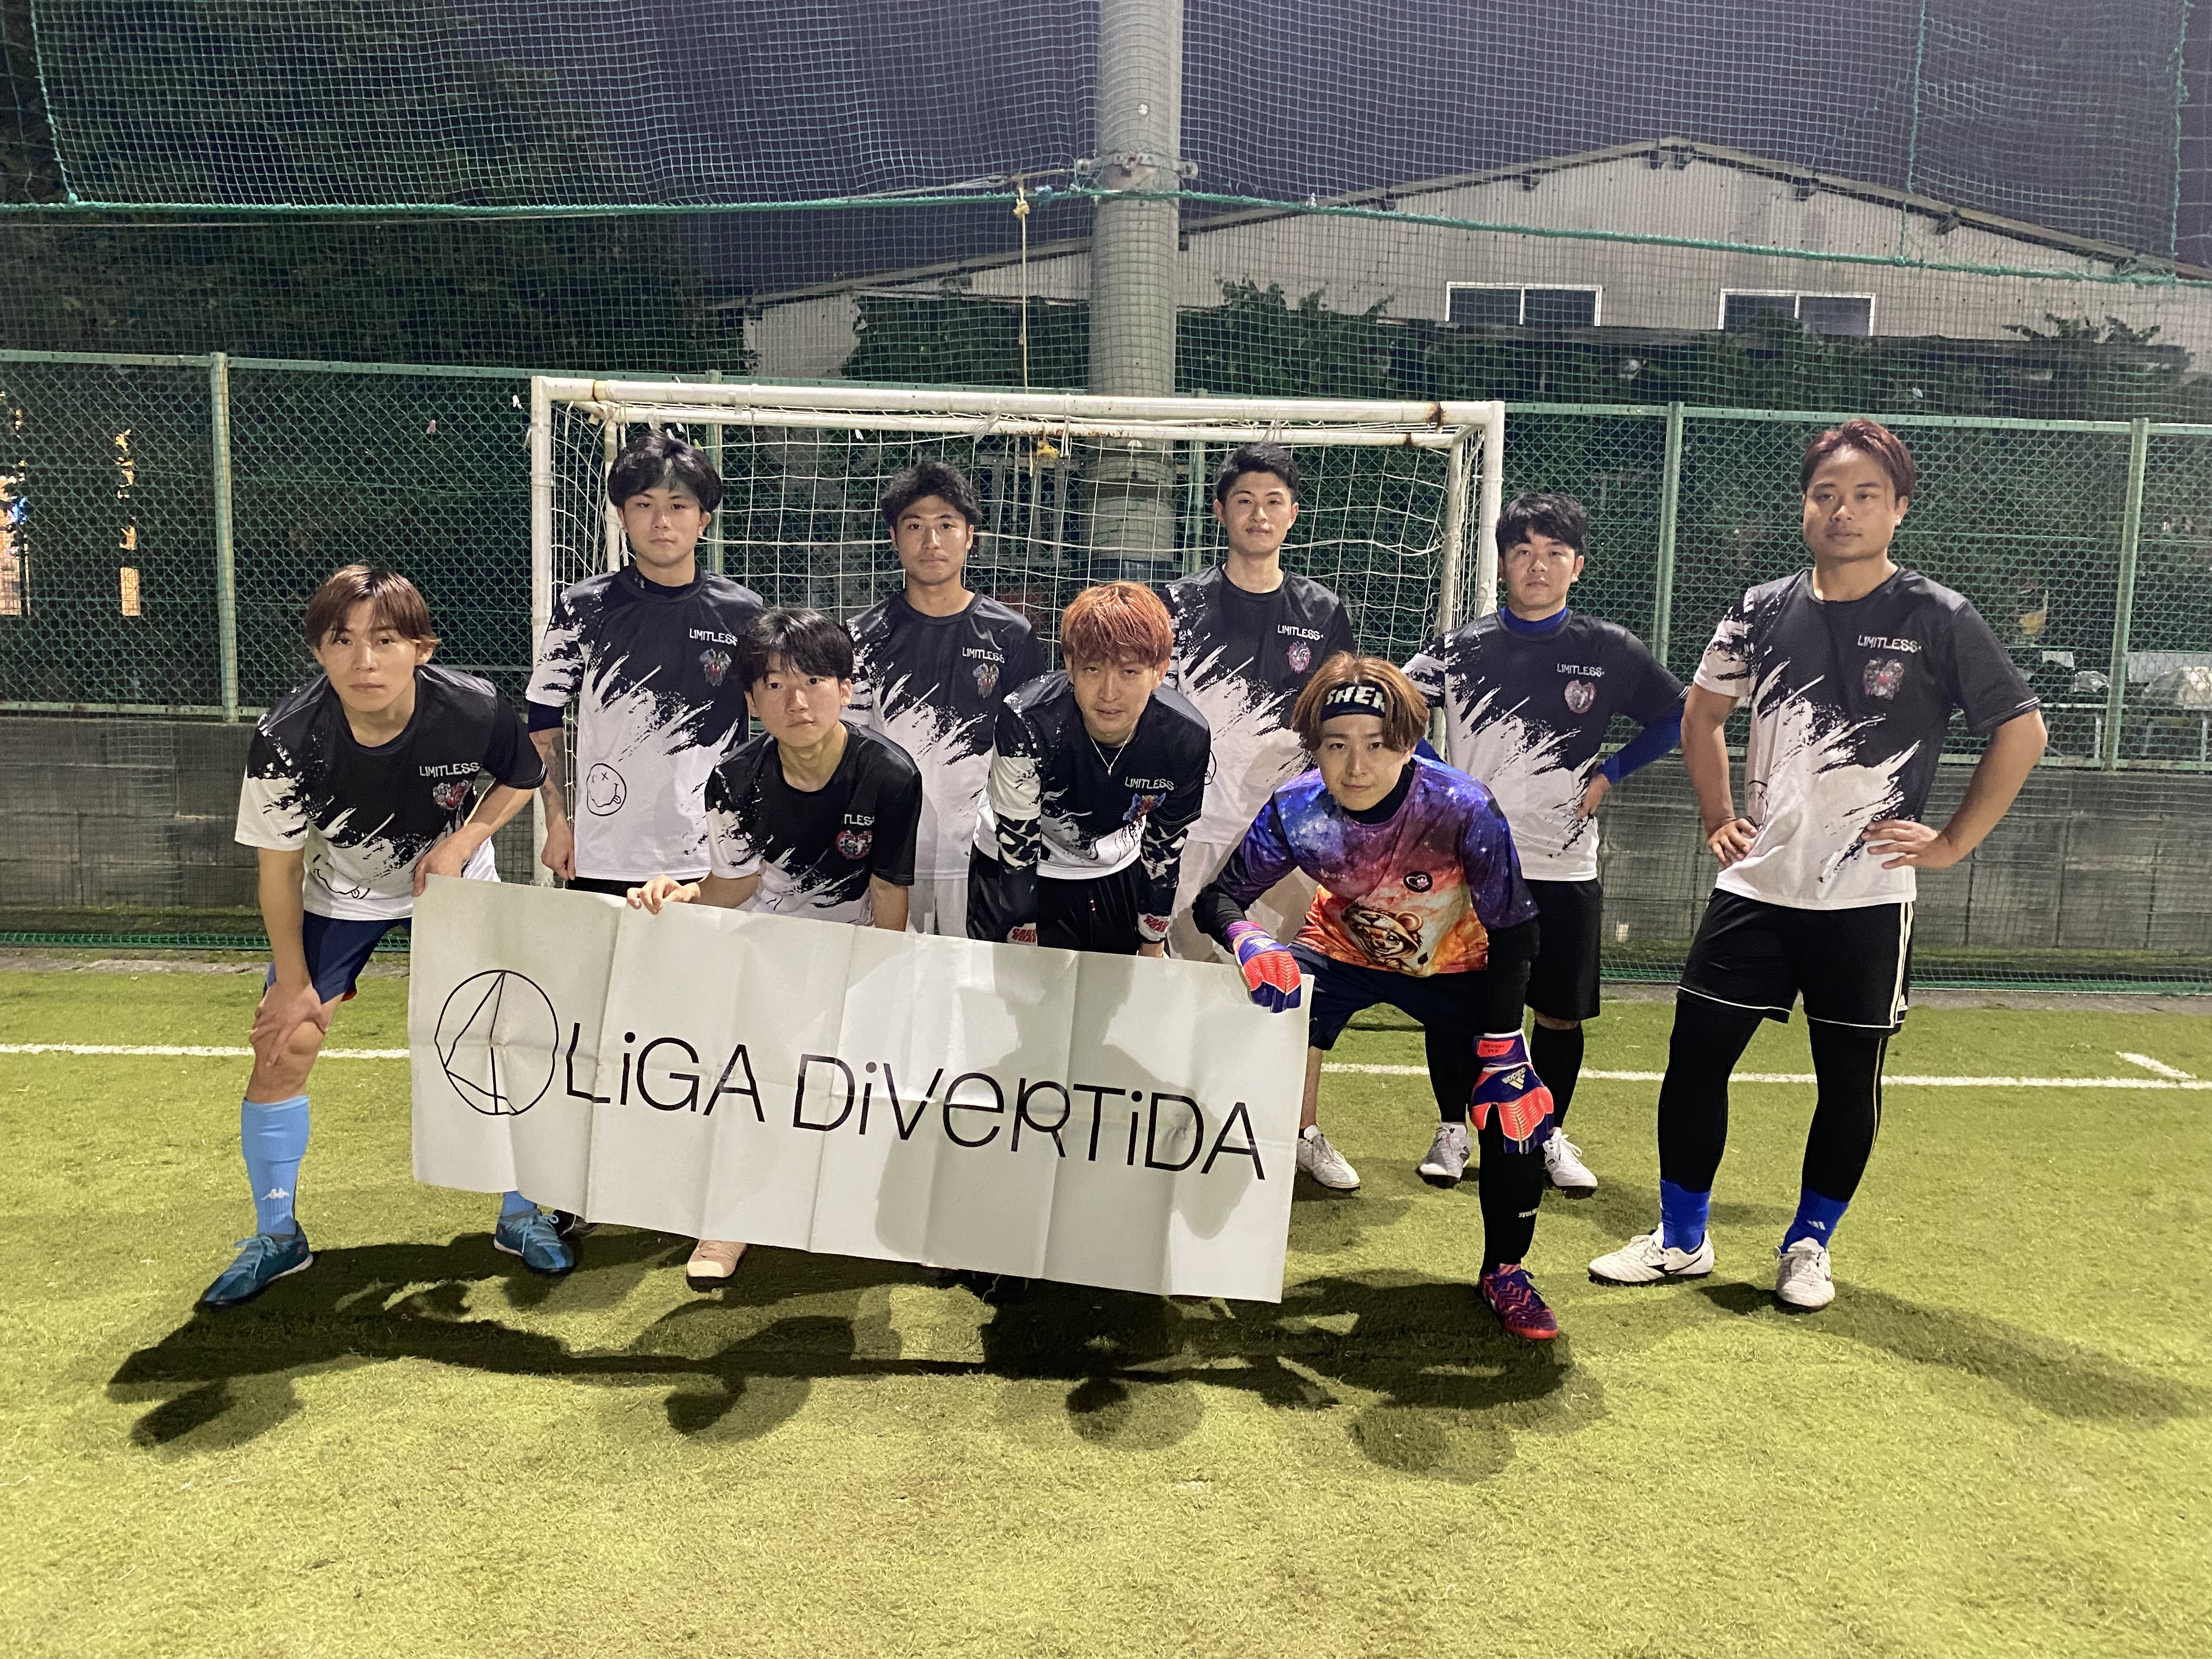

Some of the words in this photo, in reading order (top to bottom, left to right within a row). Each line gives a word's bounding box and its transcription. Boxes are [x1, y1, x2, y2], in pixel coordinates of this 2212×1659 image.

[689, 628, 738, 647] LIMITLESS
[1277, 624, 1321, 641] LIMITLESS
[1857, 635, 1918, 653] LIMITLESS
[962, 647, 1005, 664] LIMITLESS
[1557, 663, 1602, 678] LIMITLESS
[419, 762, 481, 778] LIMITLESS
[1125, 776, 1175, 791] LIMITLESS
[565, 1021, 766, 1123] LiGA
